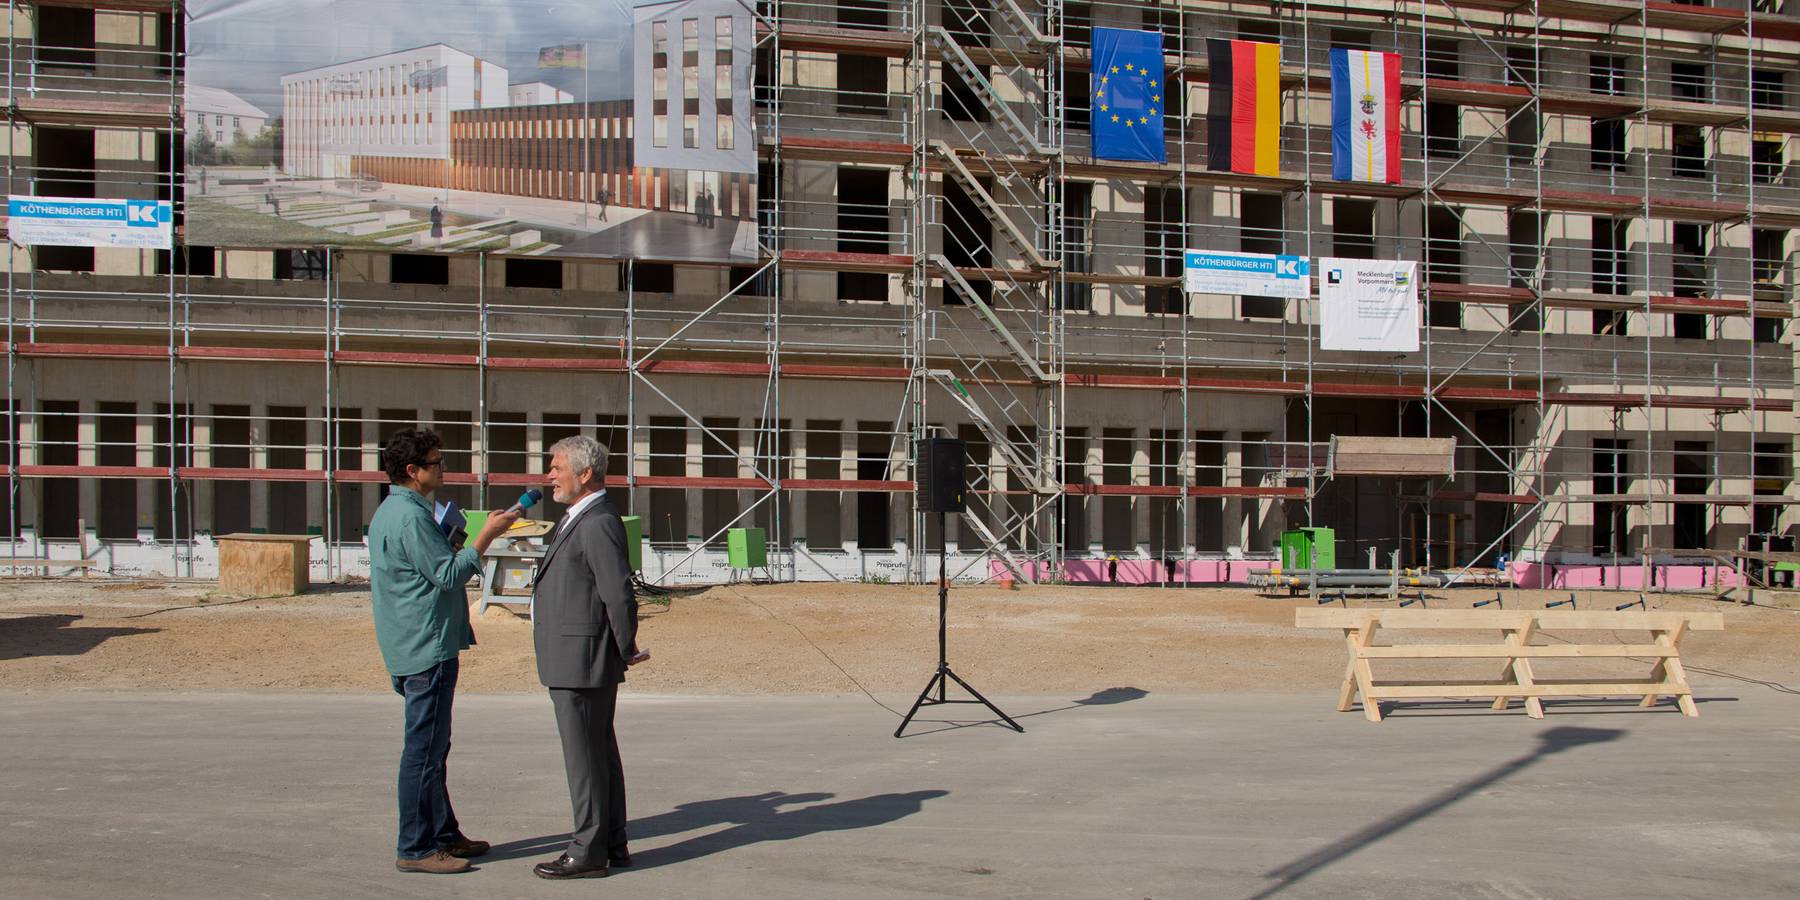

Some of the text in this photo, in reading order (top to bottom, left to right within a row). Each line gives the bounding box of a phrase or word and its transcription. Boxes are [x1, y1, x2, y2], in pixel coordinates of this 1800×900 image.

[20, 205, 104, 216] KÖTHENBÜRGER
[106, 209, 122, 217] HTI
[1194, 258, 1259, 269] KÖTHENBÜRGER
[1260, 262, 1273, 270] HTI
[1357, 271, 1394, 279] Mecklenburg
